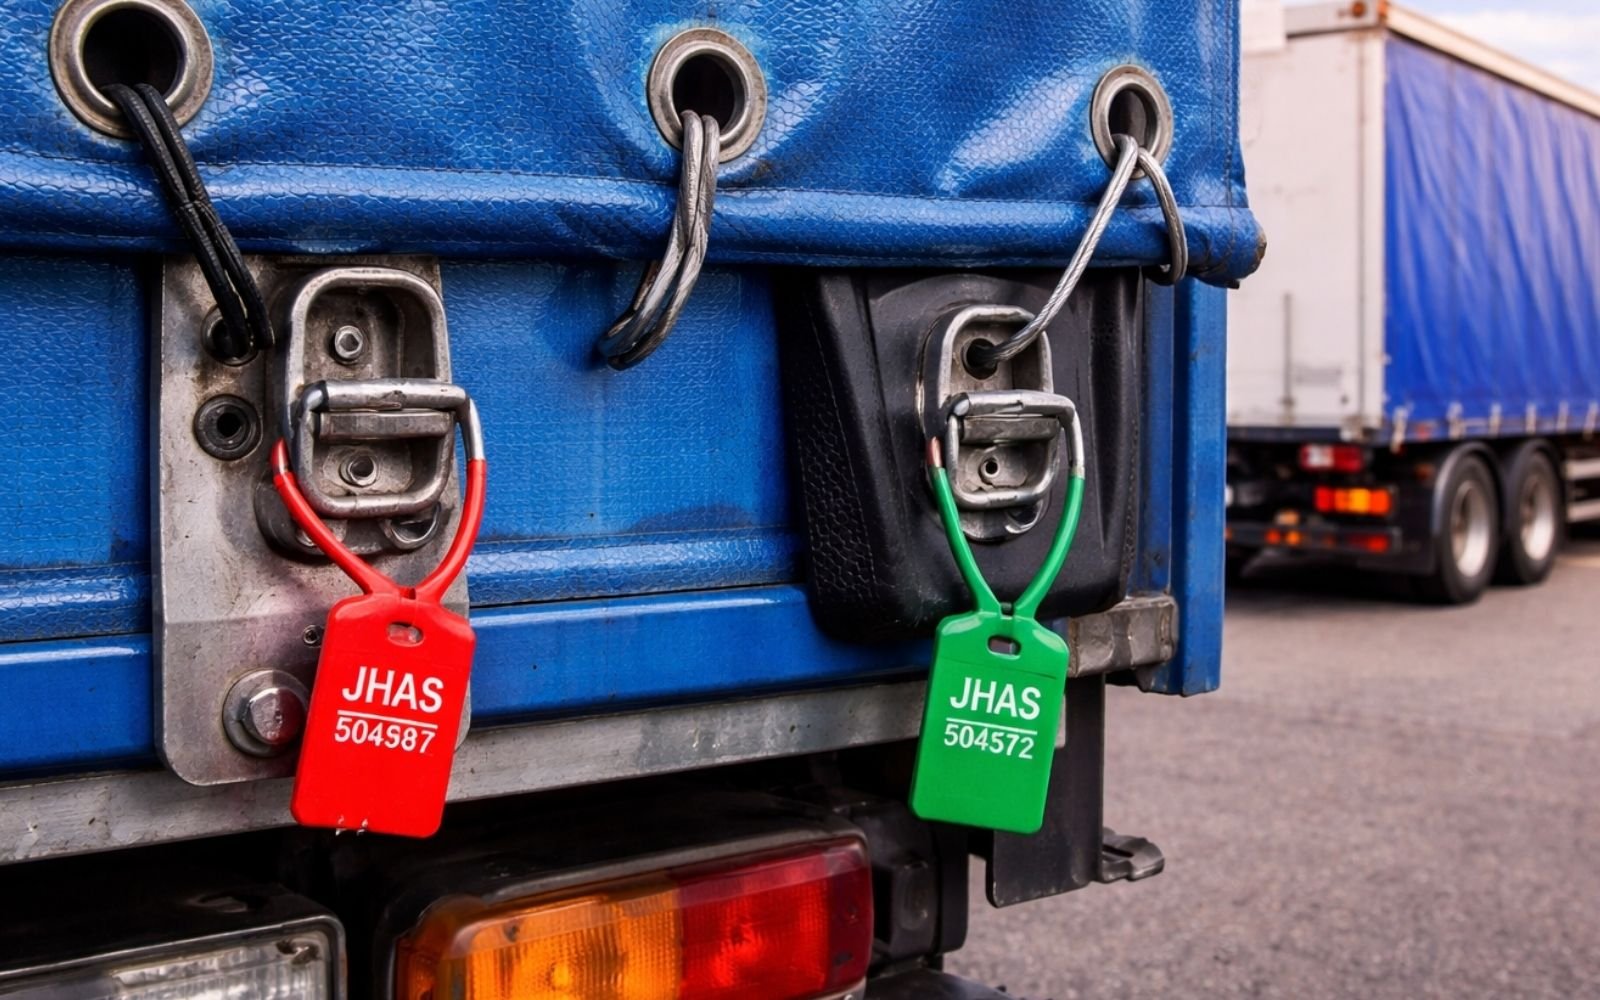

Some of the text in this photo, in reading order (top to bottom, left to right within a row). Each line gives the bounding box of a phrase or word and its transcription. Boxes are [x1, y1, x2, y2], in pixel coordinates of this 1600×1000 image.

[342, 666, 444, 713] JHAS
[949, 677, 1041, 720] JHAS
[943, 723, 1033, 759] 504572
